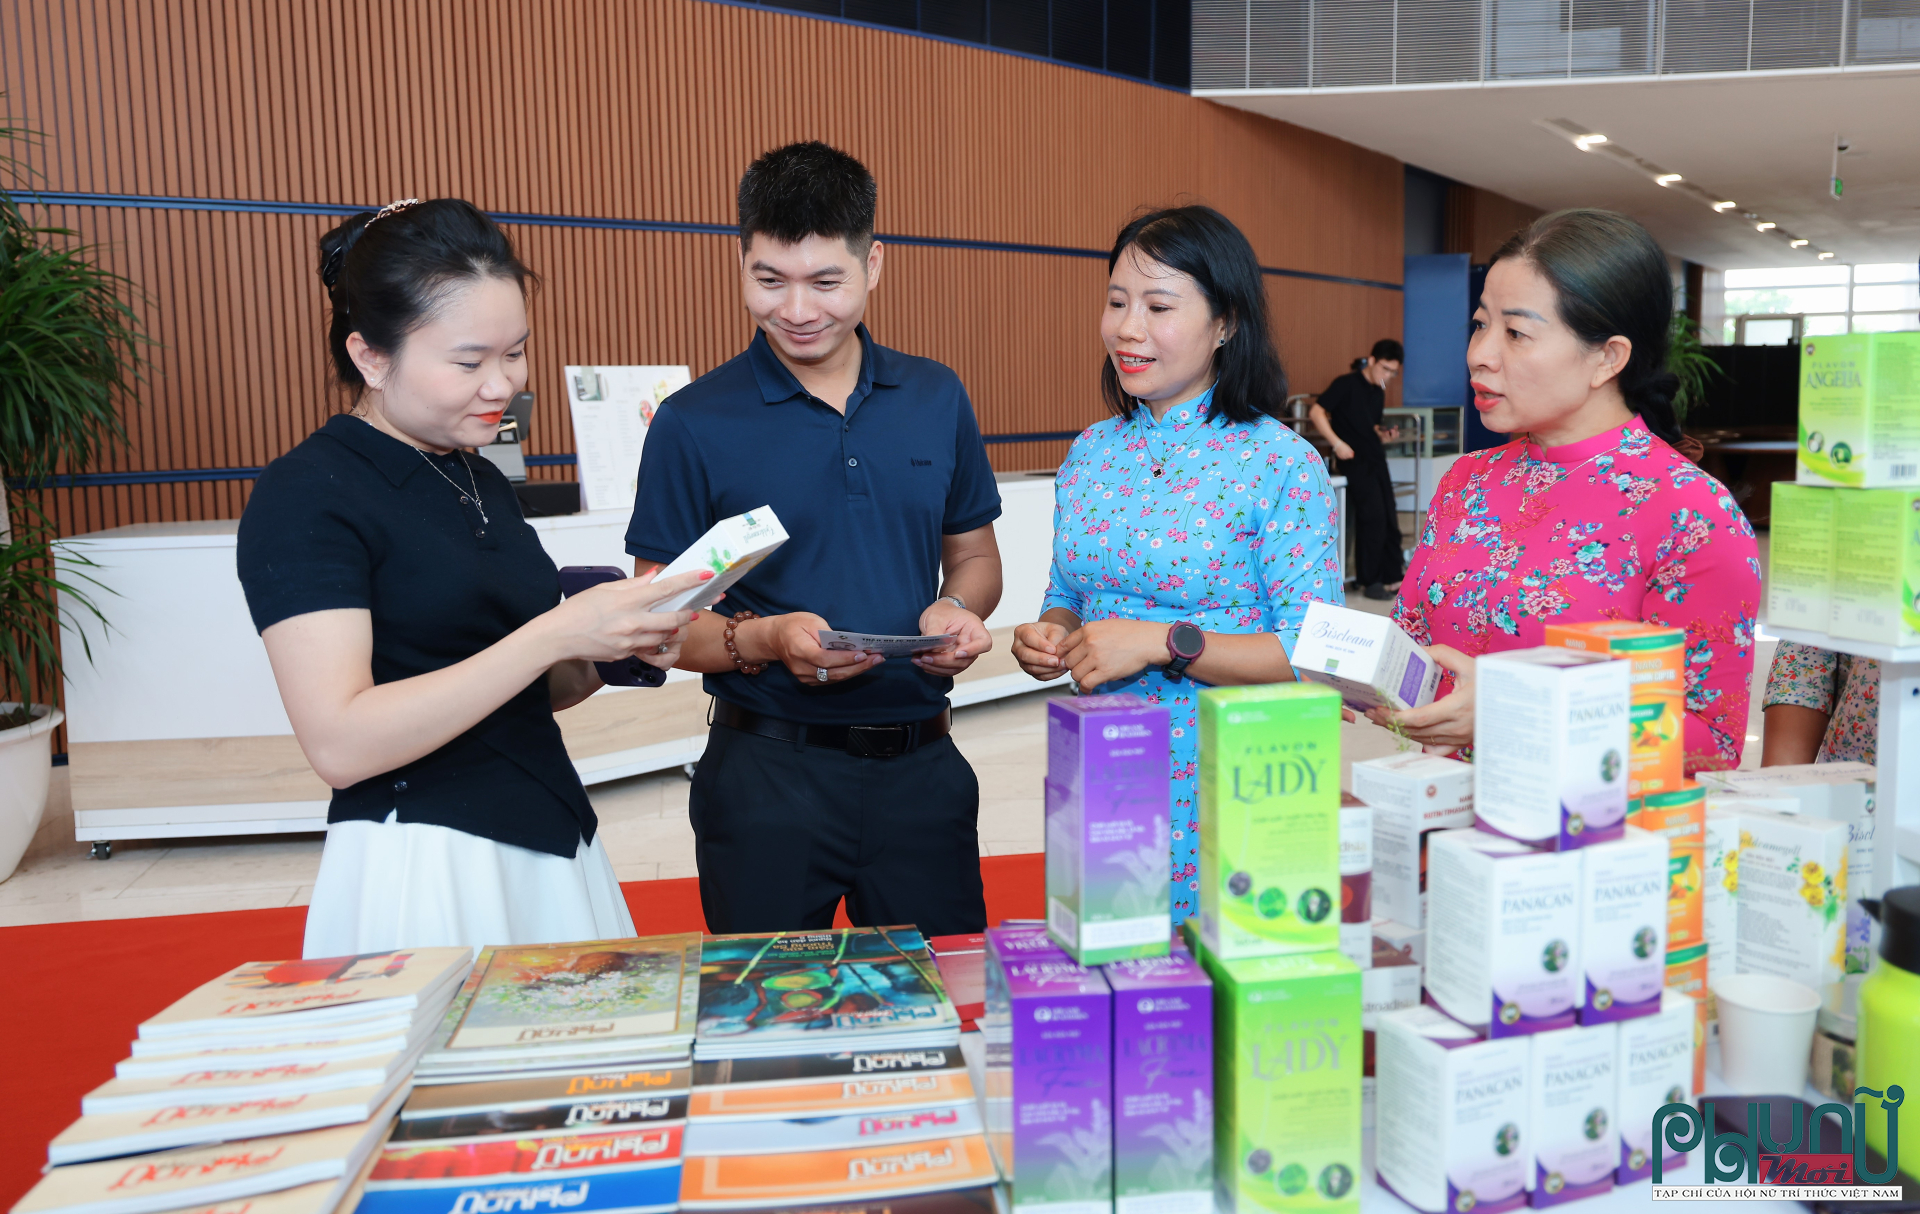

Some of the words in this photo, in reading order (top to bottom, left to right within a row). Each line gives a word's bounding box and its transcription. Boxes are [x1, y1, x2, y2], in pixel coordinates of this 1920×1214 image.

[1310, 620, 1375, 648] Biscleana
[1565, 638, 1586, 649] NANO
[1635, 658, 1662, 670] NANO
[1569, 702, 1625, 724] PANACAN
[1233, 753, 1327, 805] LADY
[1503, 891, 1574, 914] PANACAN
[1595, 879, 1662, 901] PANACAN
[1252, 1031, 1348, 1082] LADY
[1545, 1060, 1611, 1088] PANACAN
[1456, 1074, 1523, 1104] PANACAN
